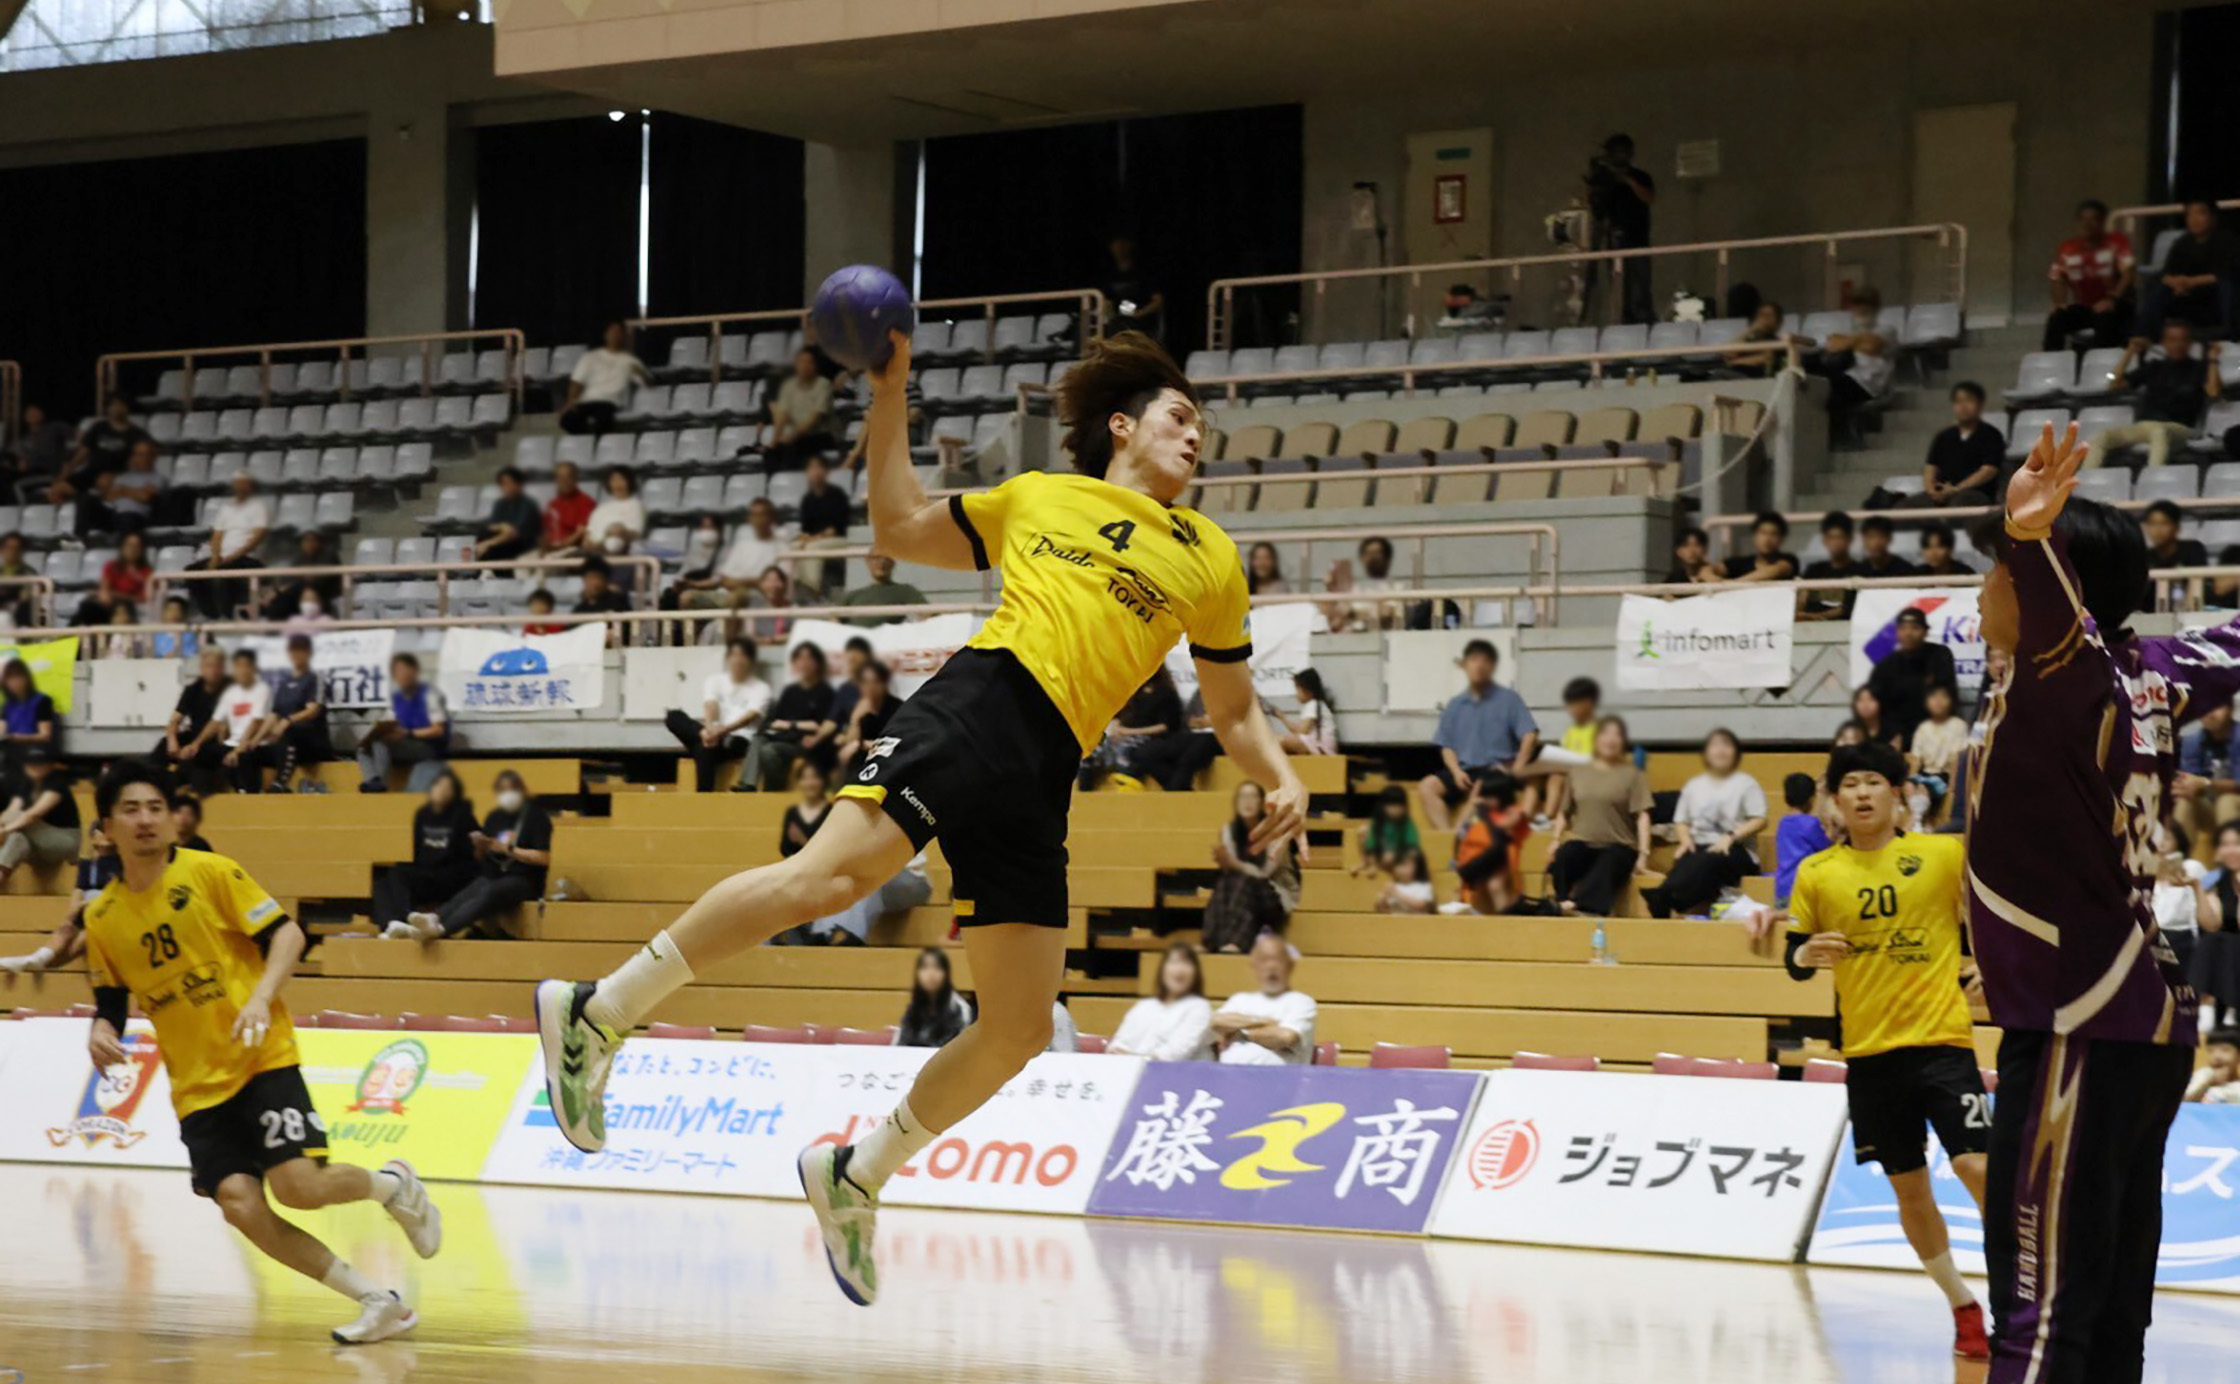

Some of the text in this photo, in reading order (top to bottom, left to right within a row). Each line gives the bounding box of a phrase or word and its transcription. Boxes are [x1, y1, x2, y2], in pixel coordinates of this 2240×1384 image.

[1098, 519, 1137, 553] 4
[1664, 627, 1775, 652] infomart
[1858, 884, 1898, 920] 20
[141, 923, 181, 968] 28
[259, 1107, 306, 1148] 28
[600, 1094, 784, 1138] amilyMart
[1557, 1132, 1806, 1198] ジョブマネ
